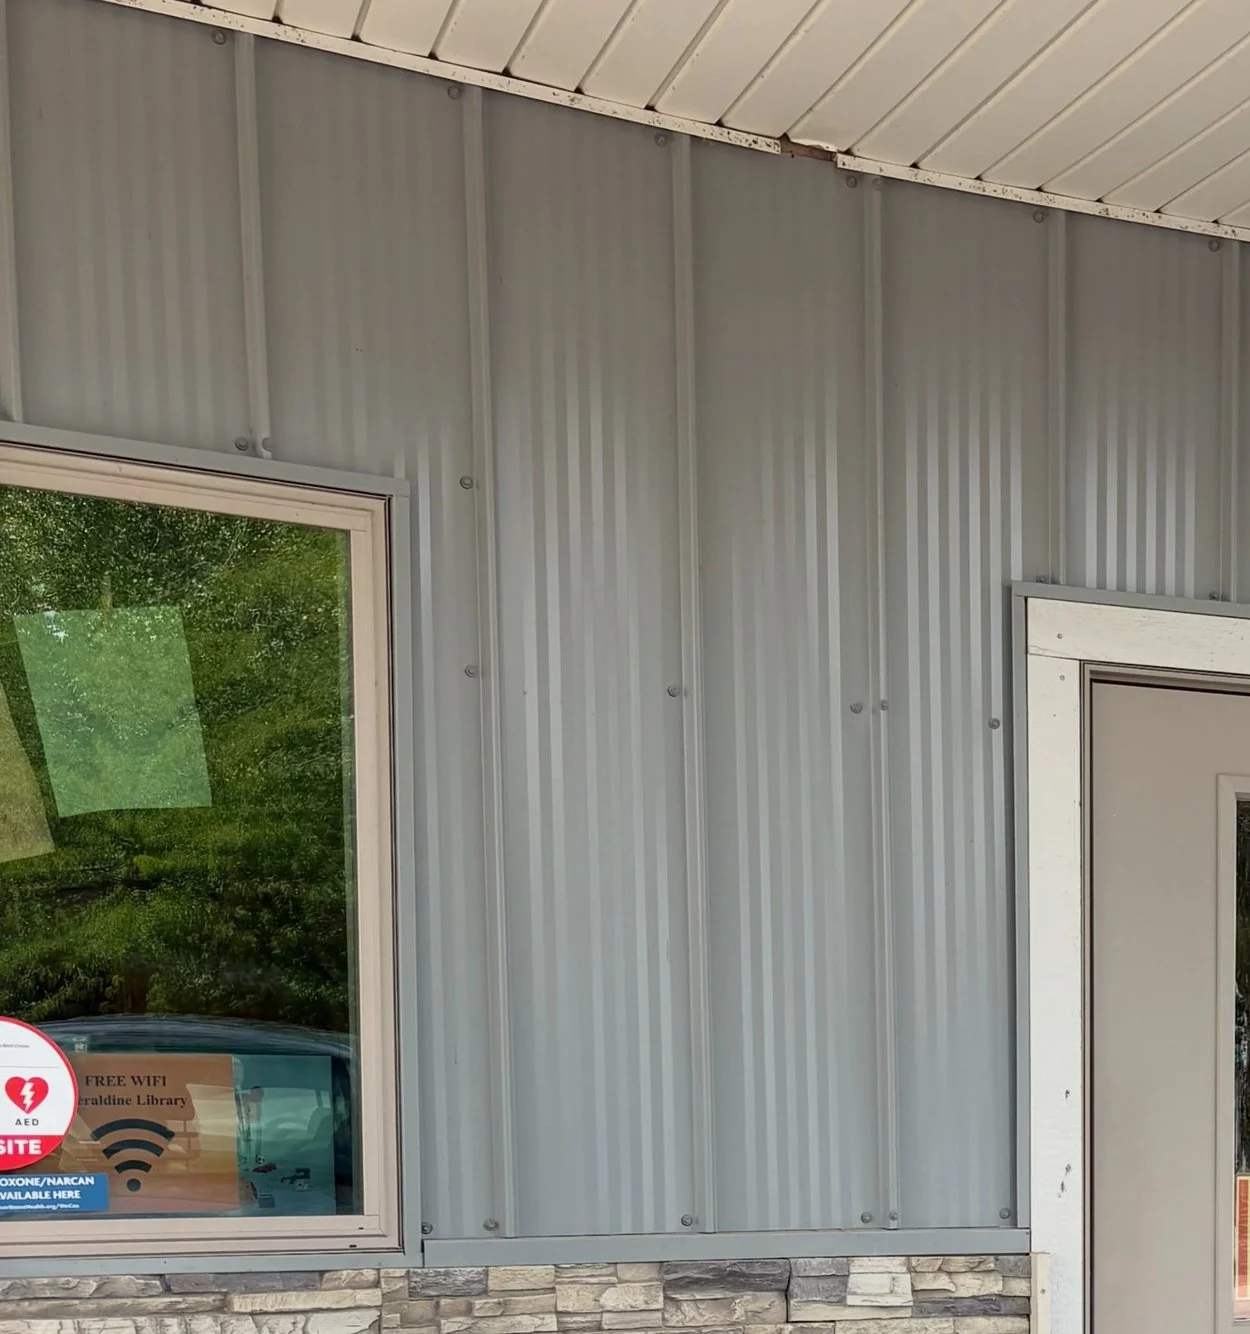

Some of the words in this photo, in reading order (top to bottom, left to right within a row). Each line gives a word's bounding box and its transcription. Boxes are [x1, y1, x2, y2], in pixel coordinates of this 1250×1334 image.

[84, 1075, 127, 1087] FREE
[131, 1075, 167, 1087] WIFI
[78, 1095, 132, 1106] eraldine
[137, 1095, 187, 1108] Library
[14, 1118, 39, 1127] AED
[0, 1190, 51, 1201] VAILABLE
[53, 1190, 82, 1200] HERE
